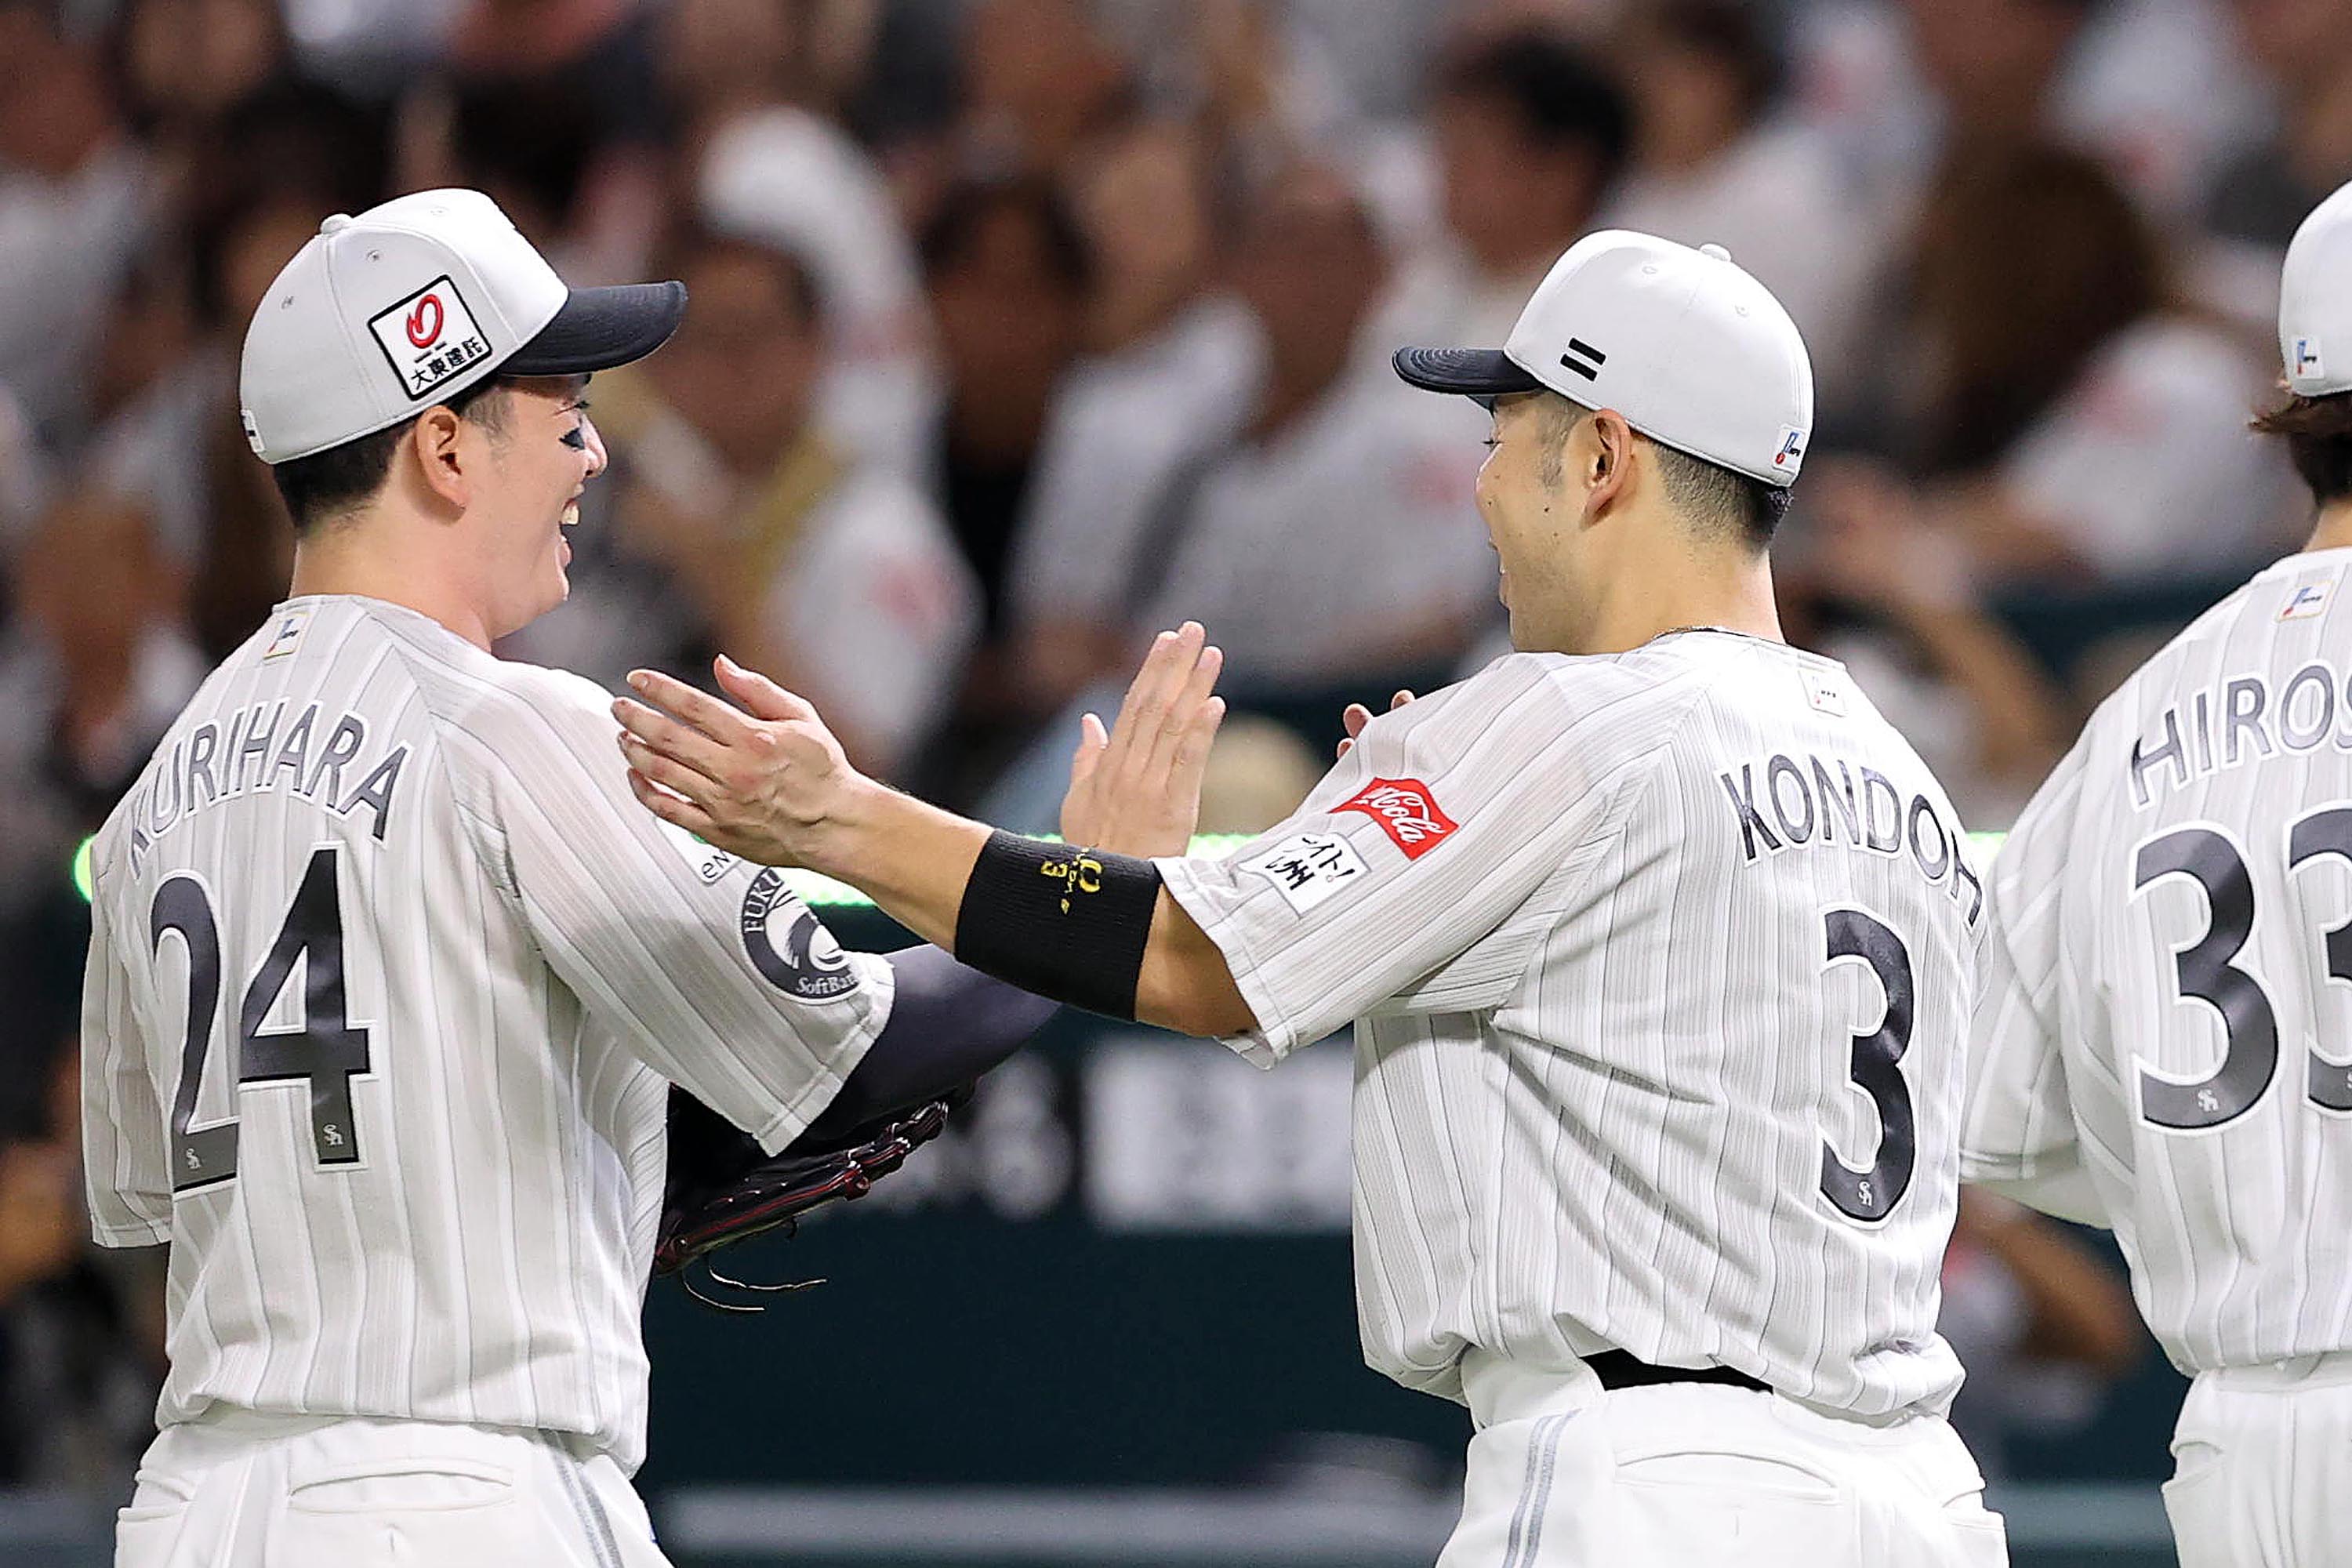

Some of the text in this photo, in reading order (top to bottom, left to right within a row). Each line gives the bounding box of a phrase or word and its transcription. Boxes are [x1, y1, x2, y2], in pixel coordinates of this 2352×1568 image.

[411, 337, 483, 390] 大東建託
[130, 702, 408, 880] KURIHARA
[1720, 754, 1982, 927] KONDOH
[150, 849, 371, 1193] 24
[1820, 909, 1915, 1221] 3
